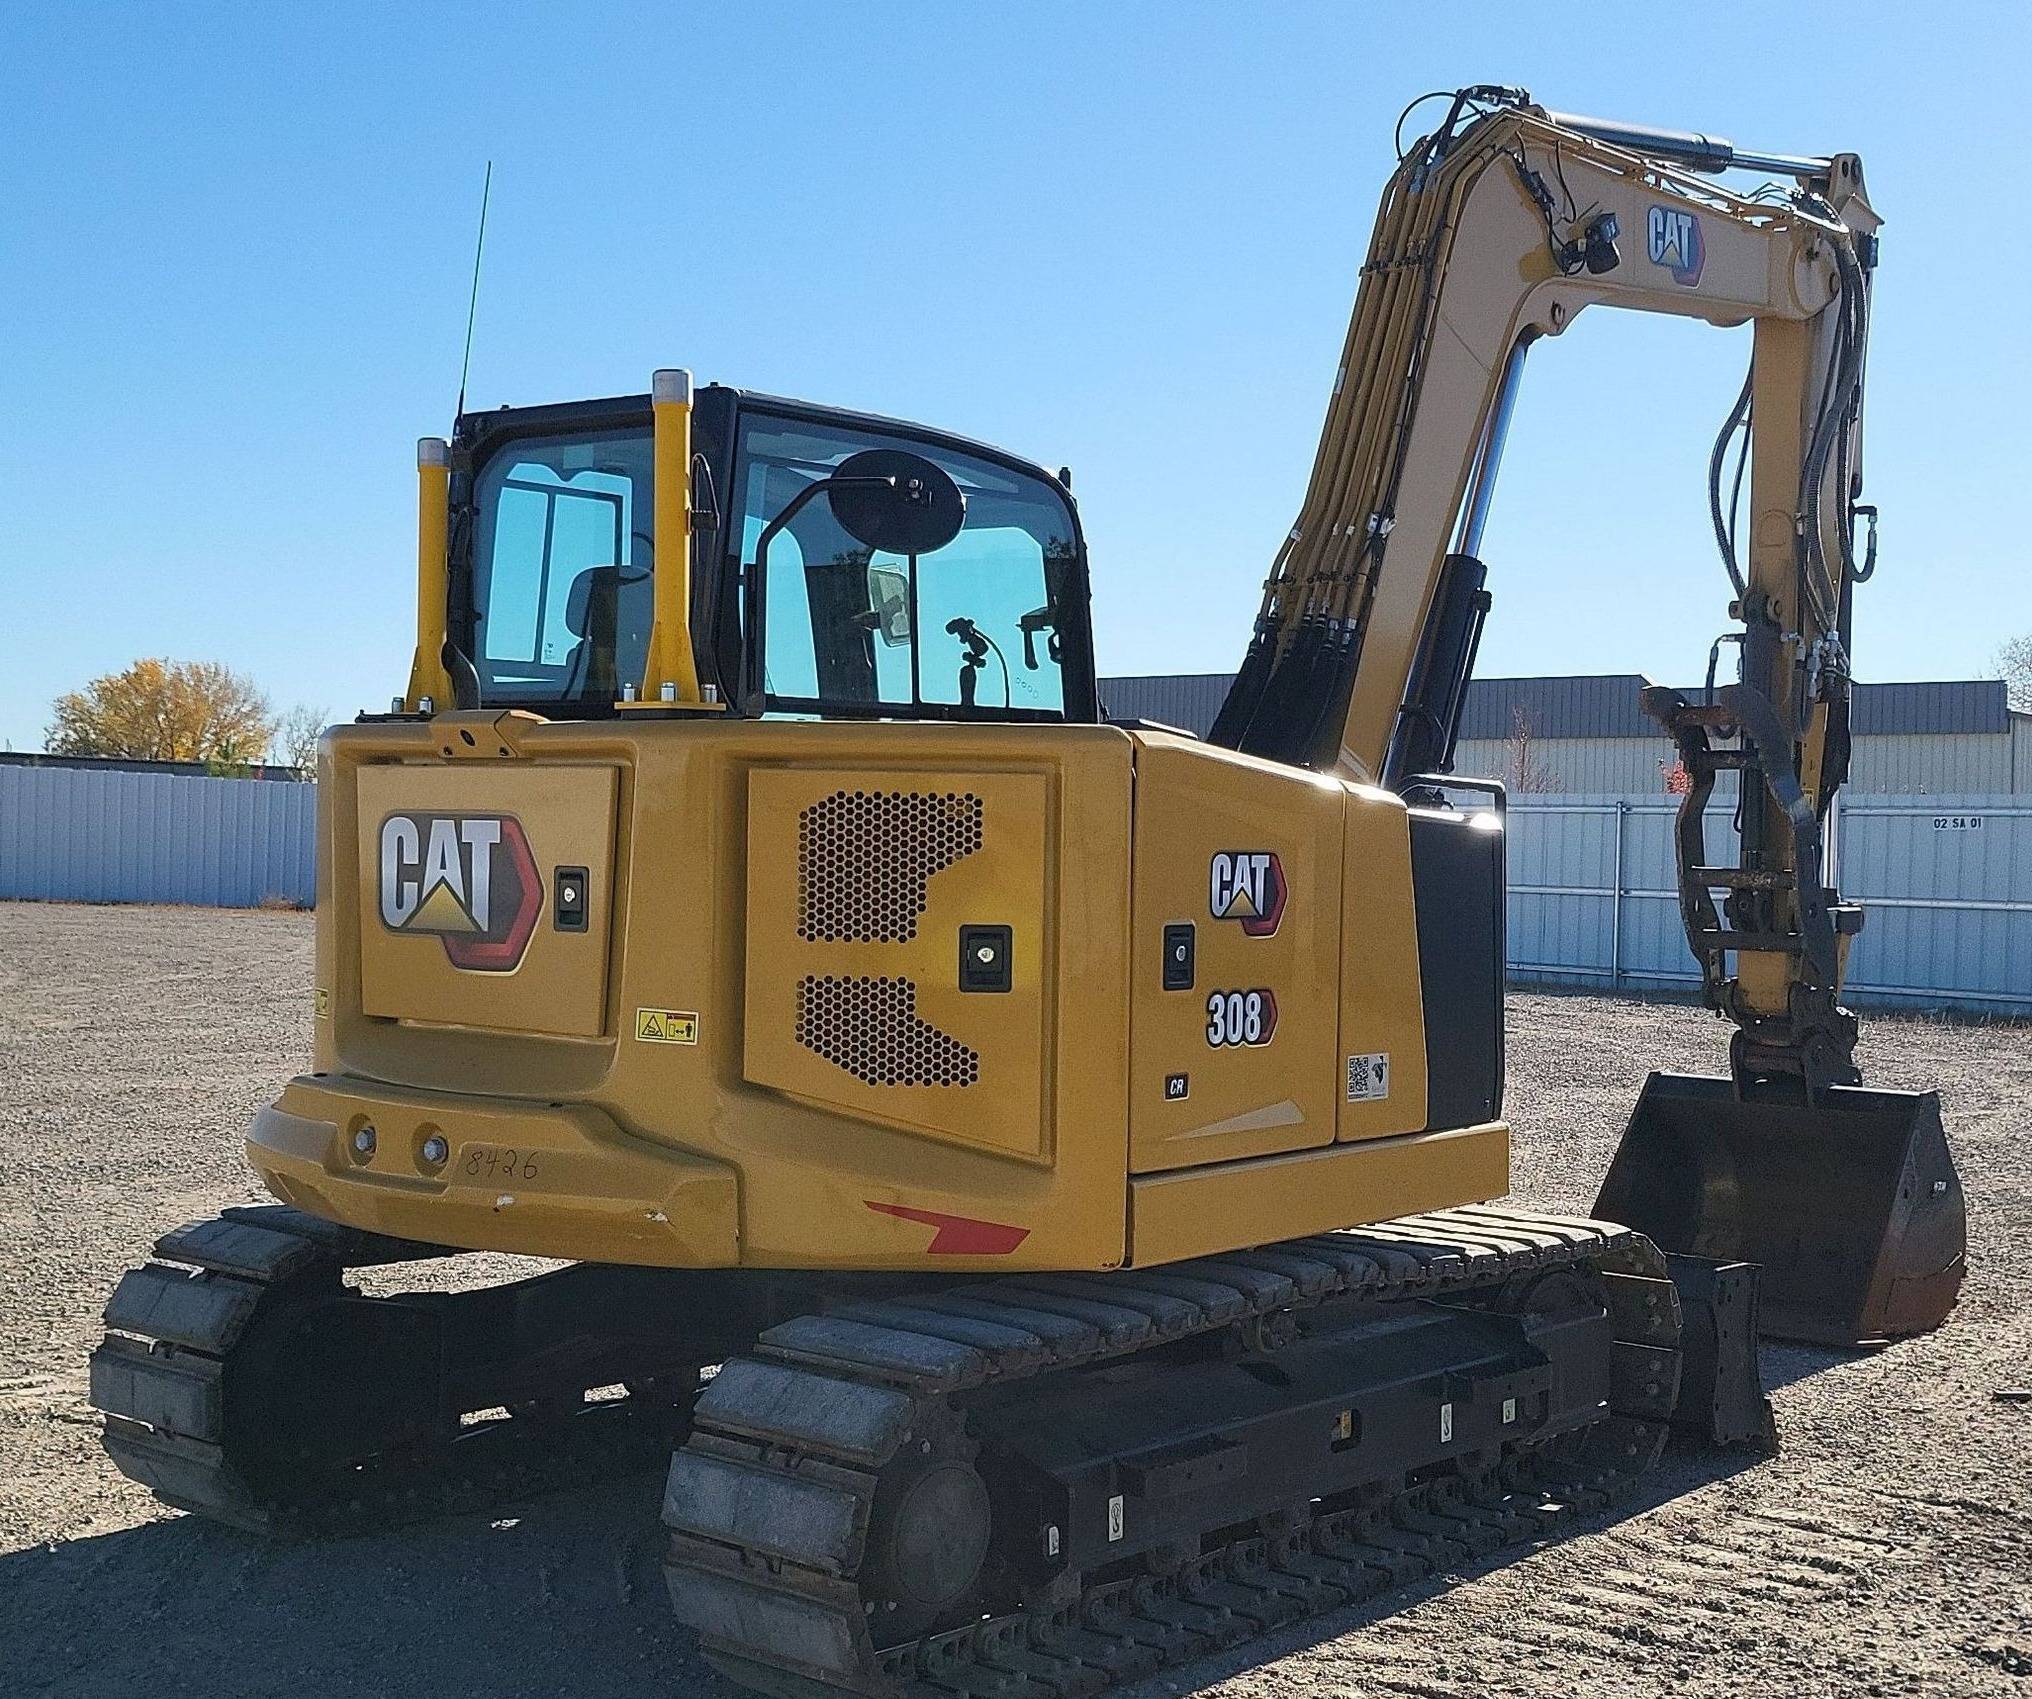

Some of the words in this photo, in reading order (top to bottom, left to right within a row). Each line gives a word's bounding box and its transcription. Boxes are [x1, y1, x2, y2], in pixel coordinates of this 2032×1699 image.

[1648, 207, 1692, 269] CAT
[1933, 818, 1948, 829] 02
[1952, 817, 1966, 829] SA
[381, 816, 501, 933] CAT
[1211, 853, 1270, 917] CAT
[1208, 992, 1262, 1045] 308
[1170, 1079, 1184, 1095] CR
[466, 1149, 538, 1180] 8426
